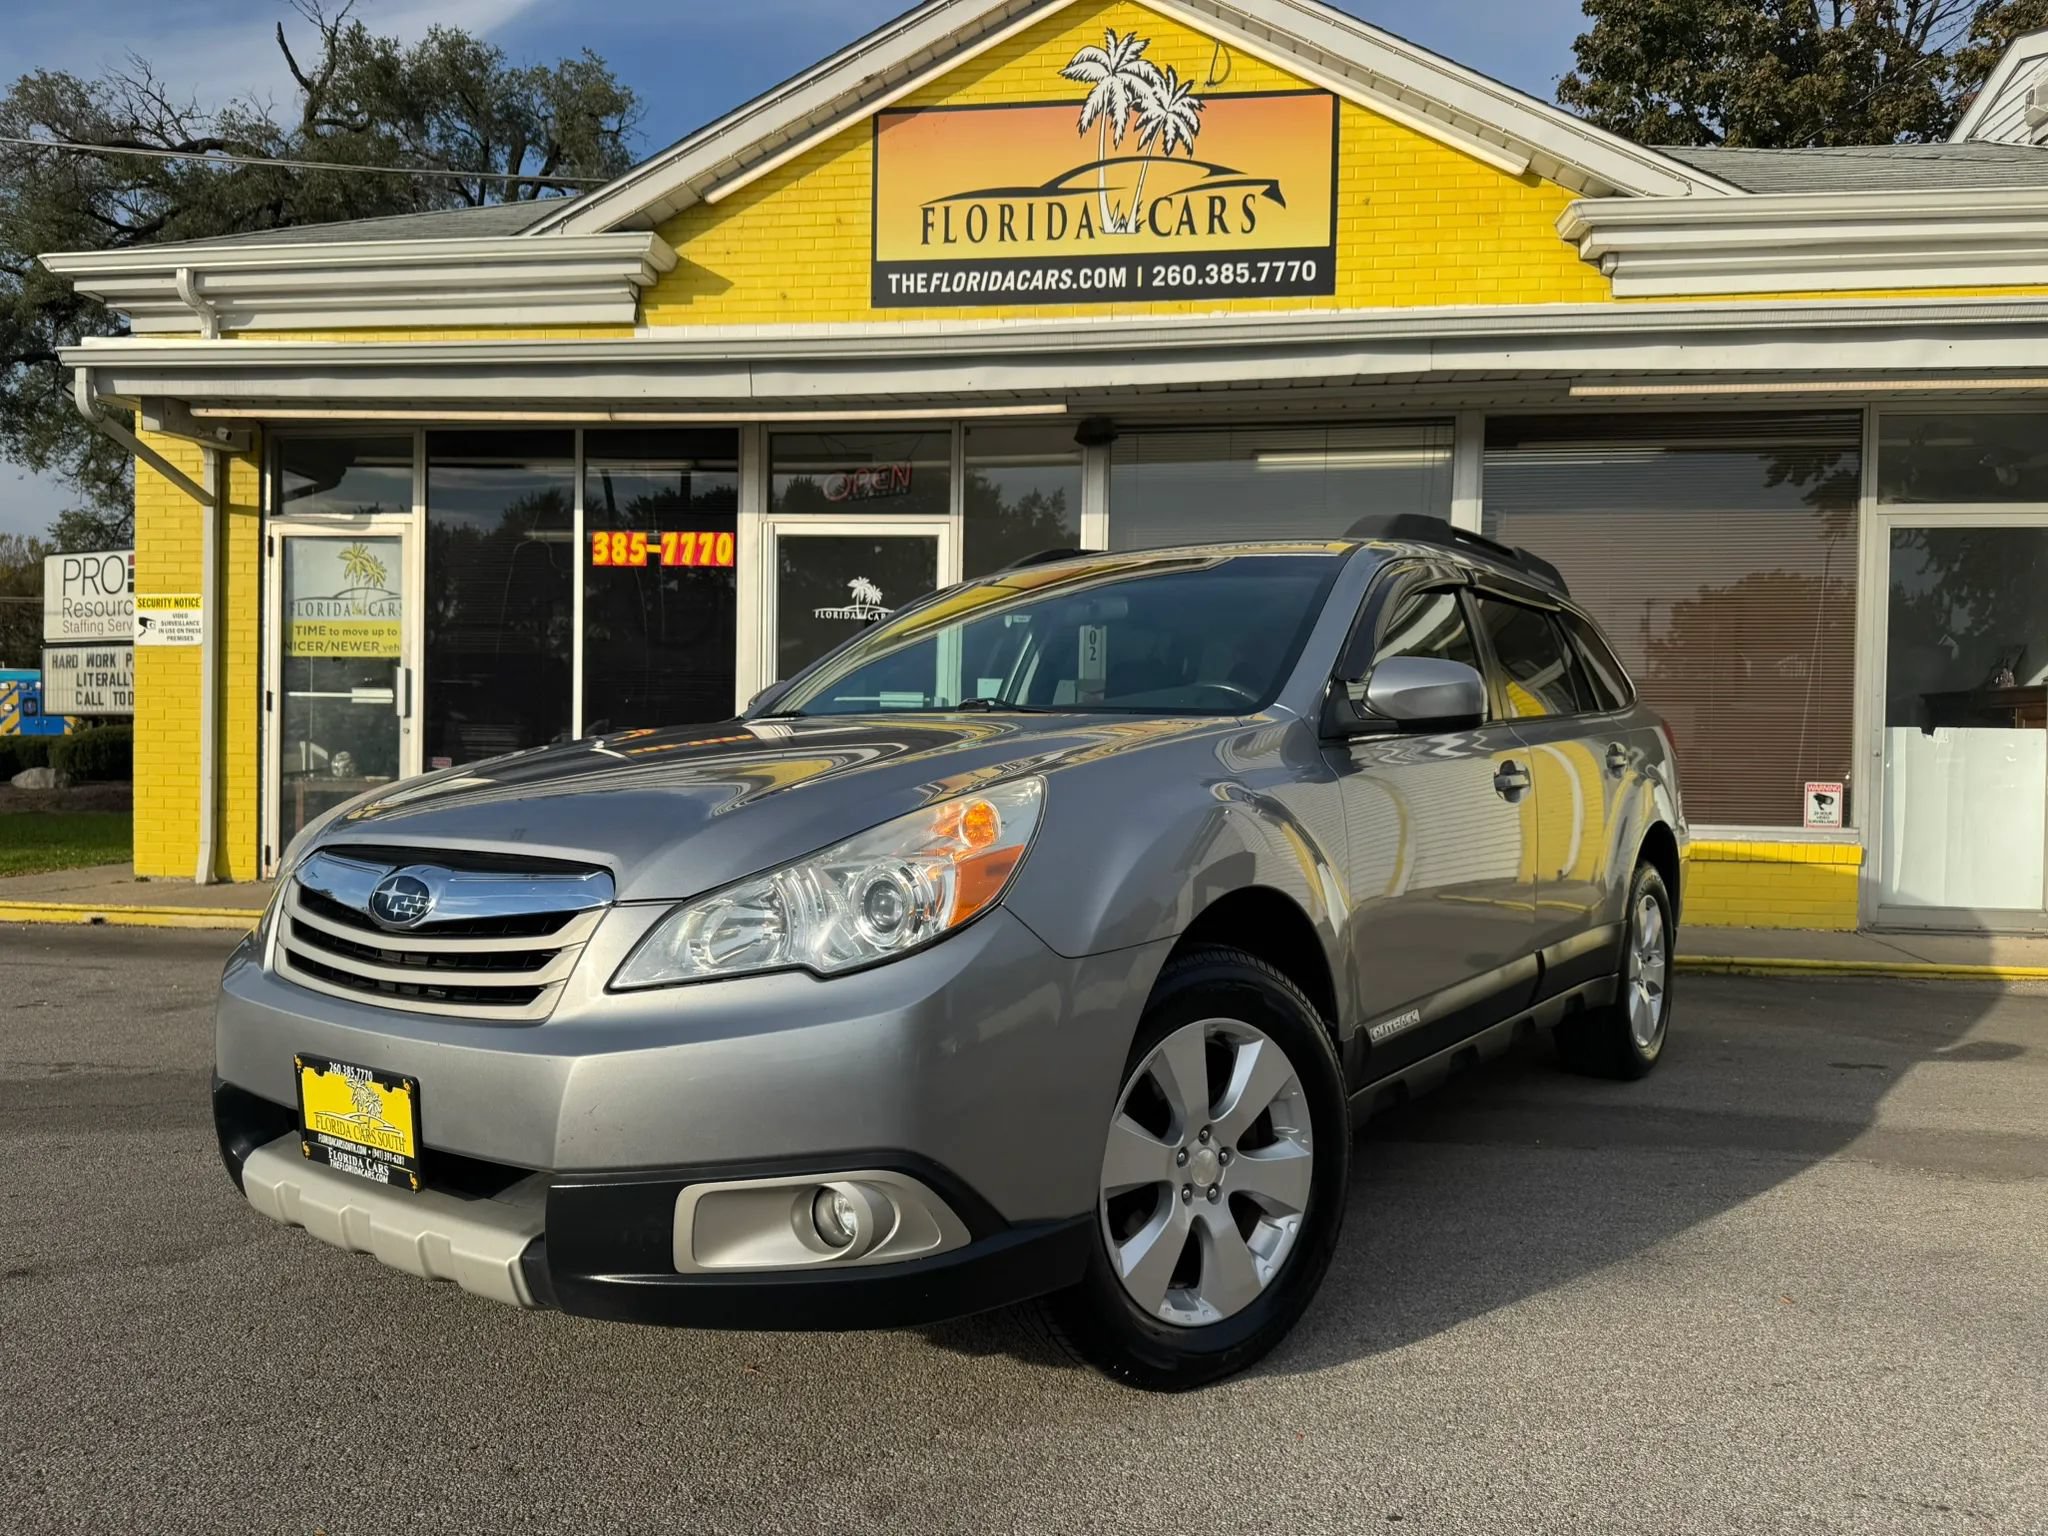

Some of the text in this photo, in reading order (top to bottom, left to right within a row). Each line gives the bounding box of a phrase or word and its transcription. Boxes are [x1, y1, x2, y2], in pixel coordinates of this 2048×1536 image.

[920, 193, 1258, 246] FLORIDA CARS
[888, 259, 1318, 295] THEFLORIDACARS.COM 260.385.7770
[823, 463, 912, 501] OPEN
[593, 531, 733, 566] 385-7770
[137, 597, 201, 609] SECURITY NOTICE
[290, 601, 352, 617] FLORIDA
[815, 610, 857, 620] FLORIDA
[63, 620, 103, 635] Staffing
[295, 625, 327, 636] TIME
[329, 628, 340, 636] to
[372, 629, 385, 639] up
[387, 628, 398, 636] to
[285, 640, 380, 653] NICER/NEWER
[52, 654, 79, 669] HARD
[86, 652, 117, 668] WORK
[75, 691, 104, 706] CALL
[329, 1061, 373, 1082] 260.385.7770
[315, 1115, 406, 1153] FLORIDA CARS SOUTH
[330, 1158, 388, 1184] THEFLORIDACARS.COM
